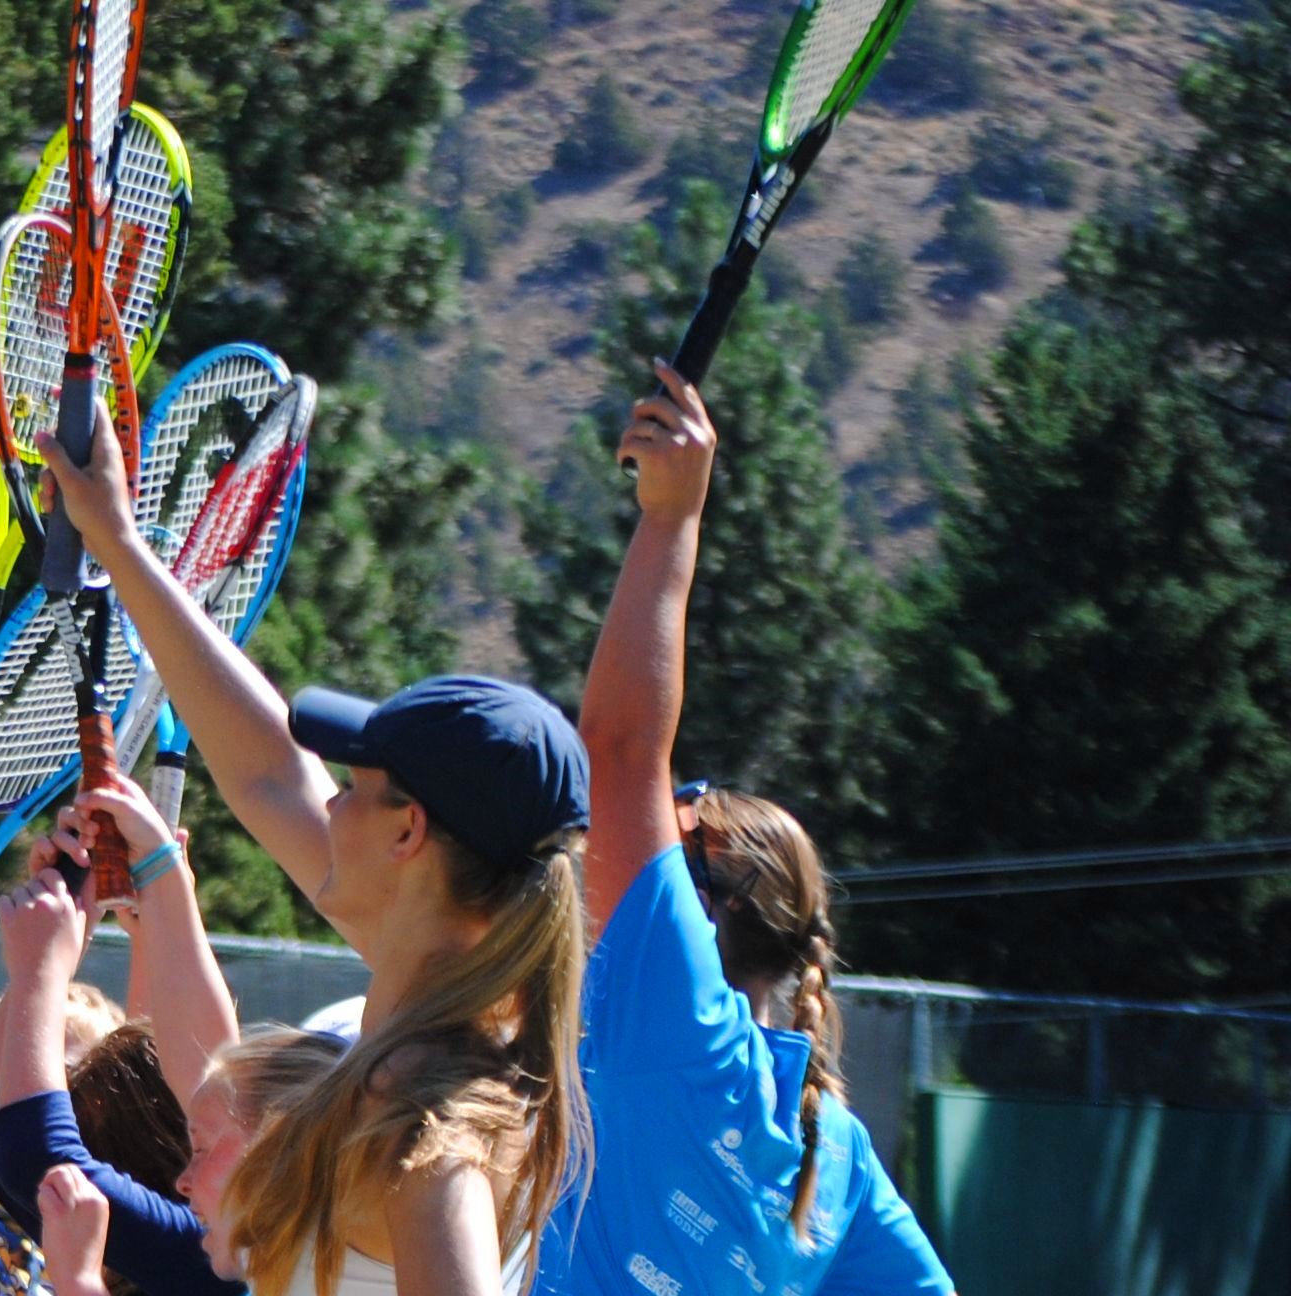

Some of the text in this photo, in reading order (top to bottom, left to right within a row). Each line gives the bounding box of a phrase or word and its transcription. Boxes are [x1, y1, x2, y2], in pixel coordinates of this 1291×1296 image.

[743, 164, 796, 249] prince
[51, 598, 85, 684] Wilson
[666, 1206, 705, 1246] VODKA
[631, 1253, 683, 1292] SOURCE
